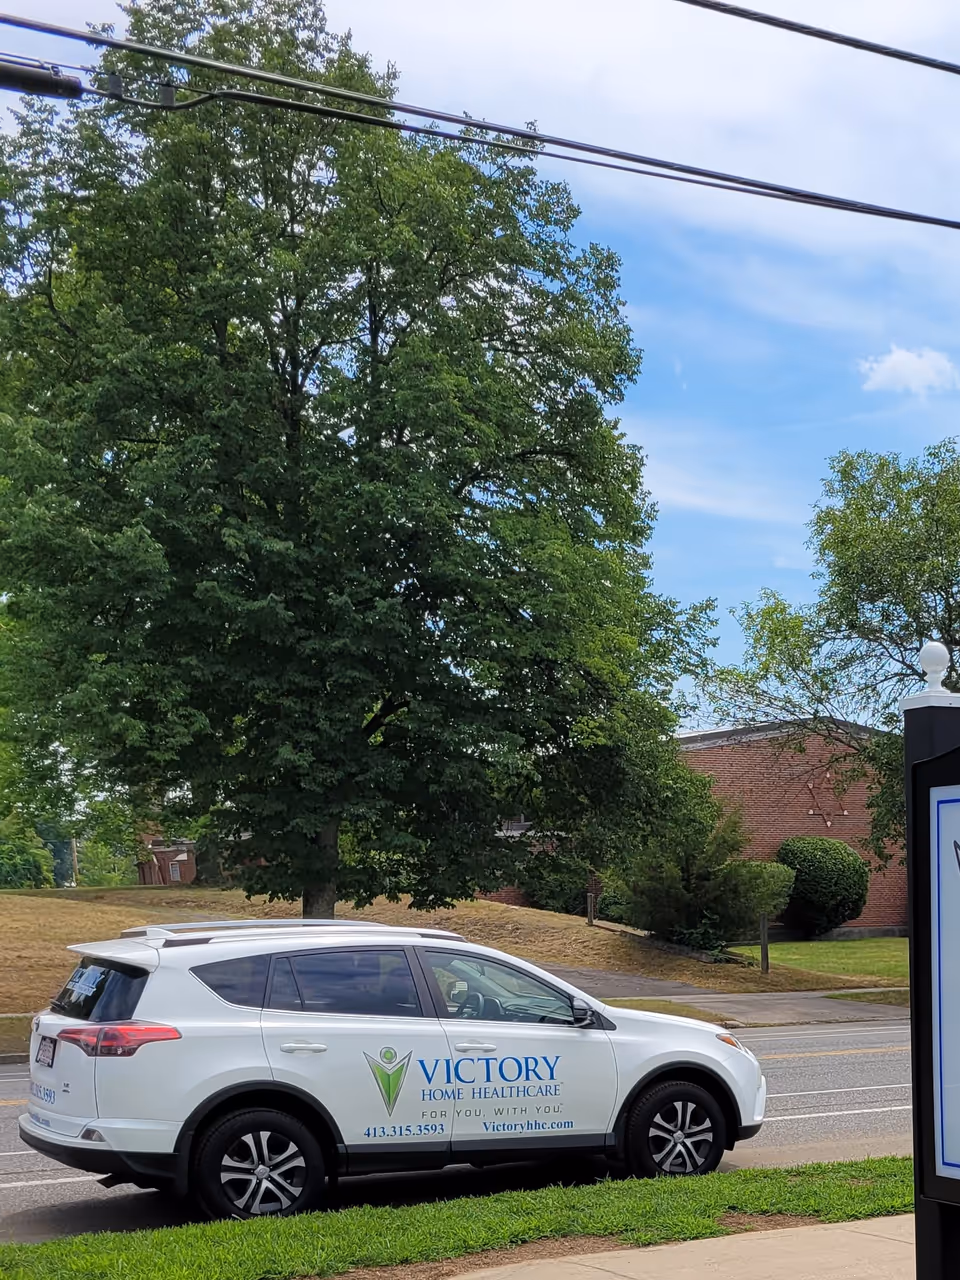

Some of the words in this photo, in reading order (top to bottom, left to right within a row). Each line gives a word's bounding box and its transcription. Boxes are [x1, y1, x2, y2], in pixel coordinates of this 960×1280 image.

[416, 1055, 563, 1085] VICTORY
[421, 1087, 464, 1102] HOME
[472, 1084, 561, 1100] HEALTHCARE
[421, 1109, 448, 1119] FOR
[456, 1108, 486, 1118] YOU,
[493, 1106, 528, 1116] WITH
[364, 1123, 445, 1138] 413.315.3593
[482, 1120, 574, 1134] Victoryhhc.com
